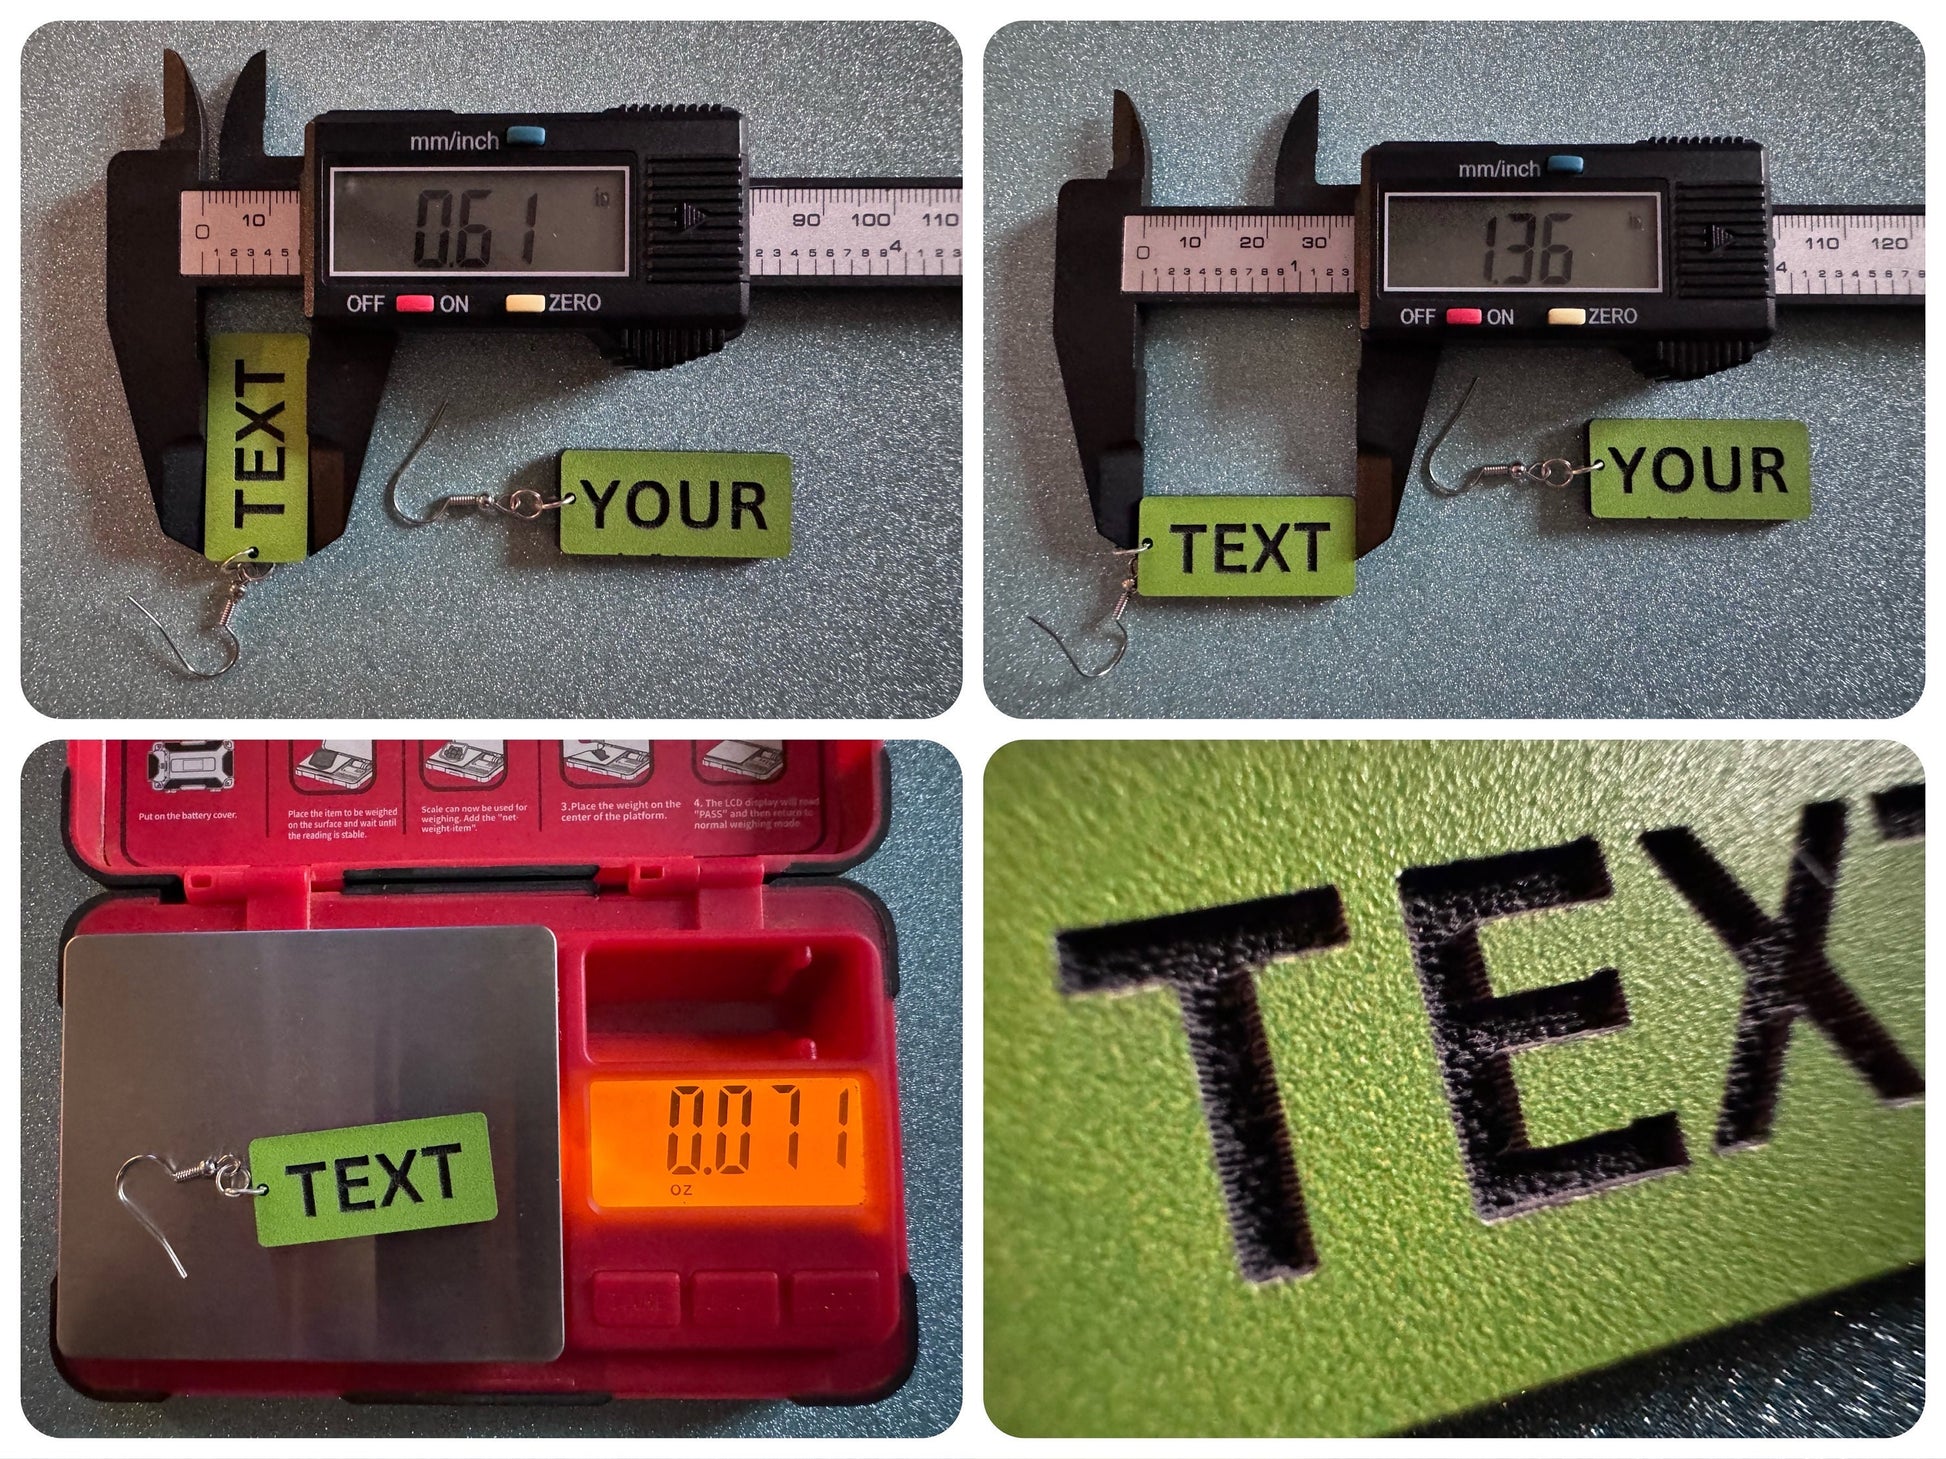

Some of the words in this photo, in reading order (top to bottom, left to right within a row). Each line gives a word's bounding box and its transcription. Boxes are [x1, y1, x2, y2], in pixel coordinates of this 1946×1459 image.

[410, 131, 500, 151] mm/inch
[1458, 160, 1541, 178] mm/inch
[242, 213, 265, 227] 10
[792, 213, 821, 227] 90
[851, 213, 891, 227] 100
[922, 213, 959, 227] 110
[195, 224, 210, 240] 0
[414, 189, 538, 268] 0.61
[889, 240, 902, 252] 4
[1179, 236, 1201, 249] 10
[1239, 236, 1265, 249] 20
[1302, 236, 1327, 249] 30
[1482, 212, 1574, 285] 1.36
[1805, 237, 1840, 250] 110
[1871, 237, 1909, 250] 120
[230, 248, 238, 257] 2
[247, 248, 255, 257] 3
[264, 248, 272, 257] 4
[281, 248, 289, 257] 5
[755, 249, 764, 257] 2
[772, 249, 782, 257] 3
[790, 249, 798, 257] 4
[808, 249, 817, 257] 5
[826, 249, 834, 257] 6
[844, 249, 852, 257] 7
[861, 249, 870, 257] 8
[880, 249, 888, 257] 9
[936, 249, 944, 257] 2
[952, 249, 962, 257] 3
[1136, 246, 1150, 260] 0
[1290, 260, 1297, 272] 1
[1776, 261, 1787, 273] 4
[1168, 268, 1176, 276] 2
[1183, 268, 1191, 276] 3
[1199, 268, 1206, 276] 4
[1214, 268, 1222, 276] 5
[1230, 268, 1238, 276] 6
[1246, 268, 1252, 276] 7
[1261, 268, 1268, 276] 8
[1276, 268, 1284, 276] 9
[1326, 268, 1334, 277] 2
[1342, 268, 1350, 277] 3
[1818, 270, 1826, 278] 2
[1834, 270, 1843, 278] 3
[1852, 270, 1860, 278] 4
[1868, 270, 1876, 278] 5
[1885, 270, 1893, 278] 6
[1902, 270, 1908, 278] 7
[1918, 270, 1926, 278] 8
[347, 295, 385, 313] OFF
[440, 295, 469, 313] ON
[548, 294, 602, 312] ZERO
[1400, 308, 1436, 325] OFF
[1487, 308, 1514, 325] ON
[1588, 307, 1638, 325] ZERO
[234, 359, 286, 529] TEXT
[1608, 446, 1788, 494] YOUR
[579, 479, 768, 531] YOUR
[1169, 522, 1331, 574] TEXT
[421, 805, 444, 814] Scale
[481, 804, 492, 812] be
[493, 804, 514, 812] used
[515, 803, 528, 811] for
[598, 801, 614, 810] the
[616, 800, 649, 811] weight
[650, 801, 663, 809] on
[665, 799, 682, 809] the
[705, 799, 722, 807] The
[725, 799, 742, 807] LCD
[139, 813, 153, 821] Put
[166, 812, 181, 820] the
[181, 812, 212, 821] battery
[288, 809, 308, 818] Place
[310, 809, 323, 817] the
[324, 808, 342, 817] item
[344, 809, 352, 817] to
[353, 808, 363, 816] be
[365, 808, 398, 818] weighed
[561, 813, 591, 822] center
[593, 811, 604, 821] of
[605, 812, 621, 821] the
[622, 811, 668, 822] platform.
[730, 809, 748, 818] and
[749, 808, 771, 818] then
[300, 820, 314, 828] the
[314, 820, 342, 828] surface
[360, 819, 377, 827] wait
[378, 818, 397, 827] until
[421, 815, 462, 825] weighing.
[463, 814, 480, 822] Add
[481, 814, 496, 822] the
[694, 820, 727, 830] normal
[730, 820, 773, 830] weighing
[288, 832, 301, 840] the
[302, 831, 332, 841] reading
[334, 831, 340, 839] is
[341, 830, 367, 839] stable.
[667, 1084, 849, 1176] 0.071
[284, 1142, 462, 1218] TEXT
